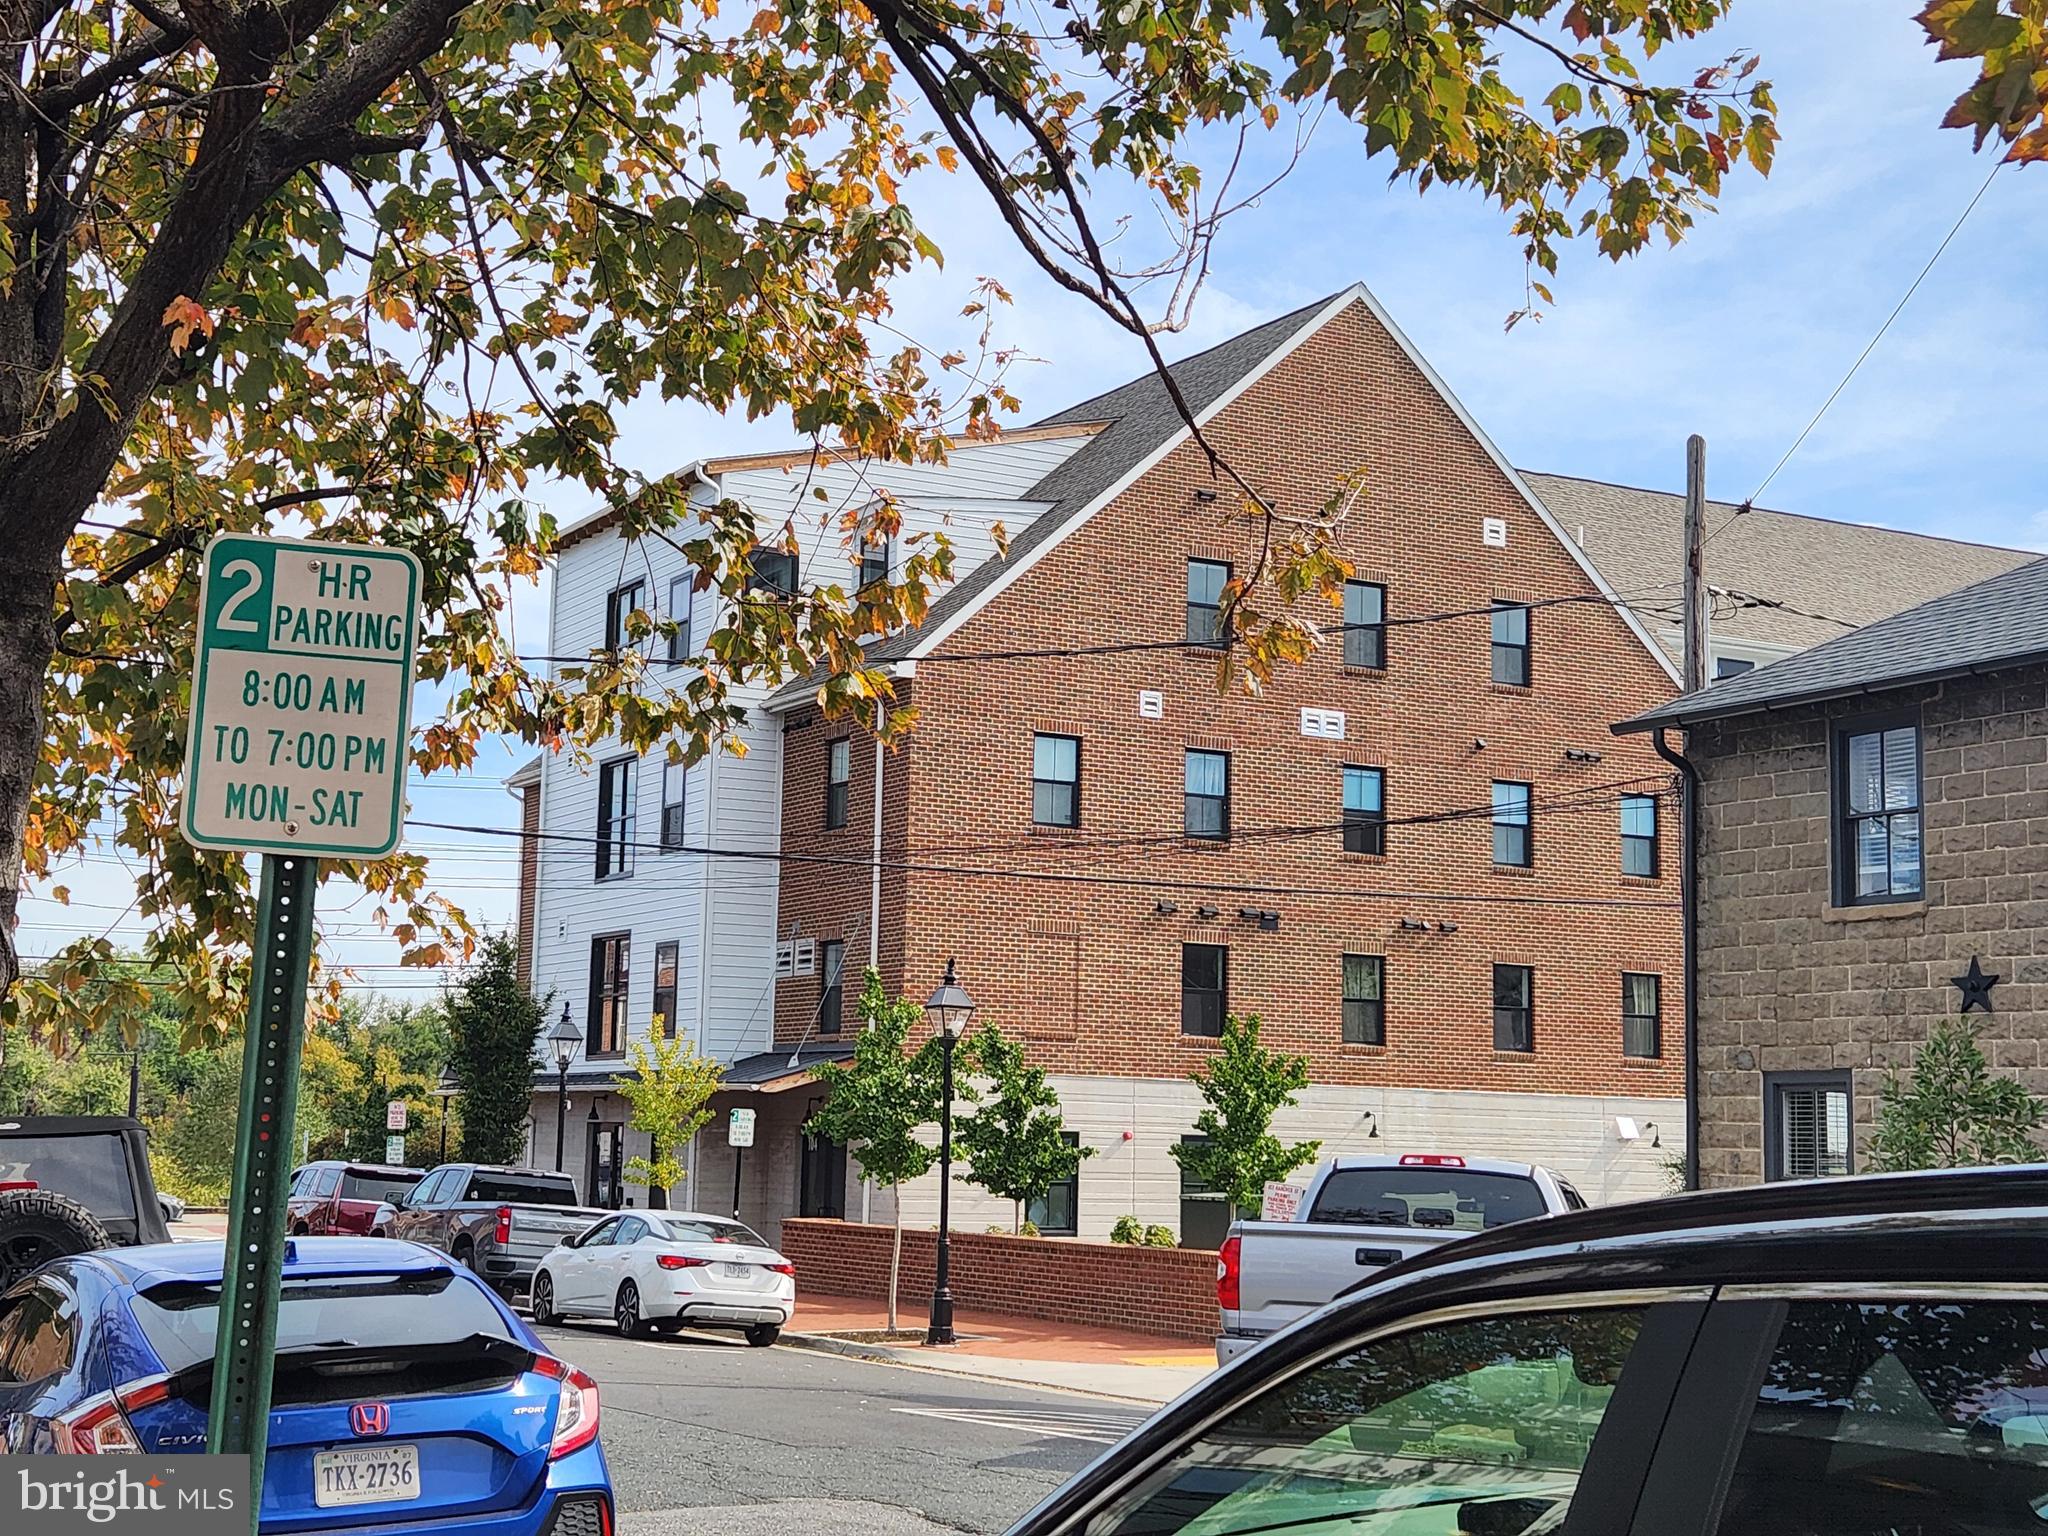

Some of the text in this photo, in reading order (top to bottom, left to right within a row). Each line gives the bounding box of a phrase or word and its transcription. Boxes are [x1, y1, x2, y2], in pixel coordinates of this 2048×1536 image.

[216, 559, 263, 633] 2
[318, 562, 372, 601] HR
[274, 605, 402, 651] PARKING
[214, 725, 249, 763] TO
[225, 782, 363, 828] MON-SAT
[512, 1406, 547, 1415] SPORT
[322, 1460, 413, 1492] TKX-2736
[341, 1451, 391, 1464] VIRGINIA
